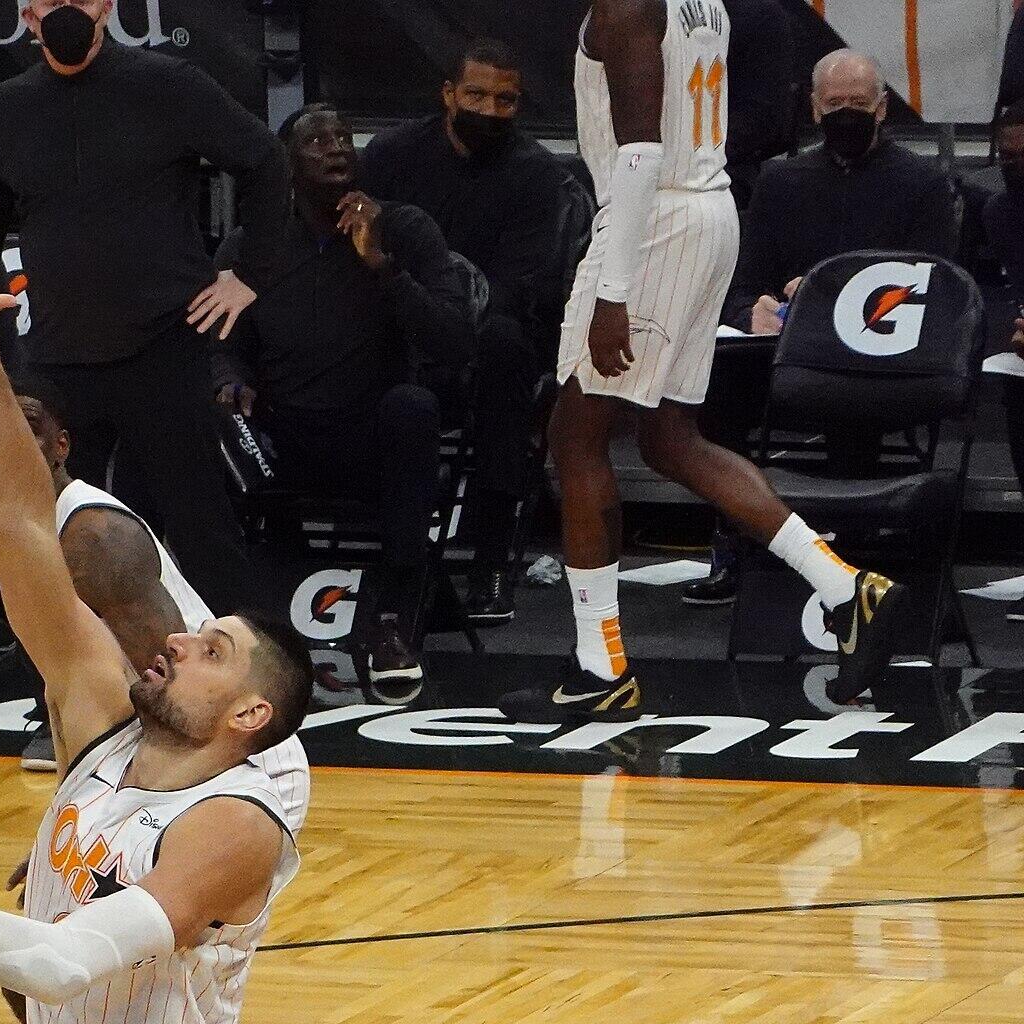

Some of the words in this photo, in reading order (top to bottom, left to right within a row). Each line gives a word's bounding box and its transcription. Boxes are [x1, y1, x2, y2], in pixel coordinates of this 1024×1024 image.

[687, 53, 726, 153] 11
[833, 261, 932, 356] G
[290, 568, 364, 641] G
